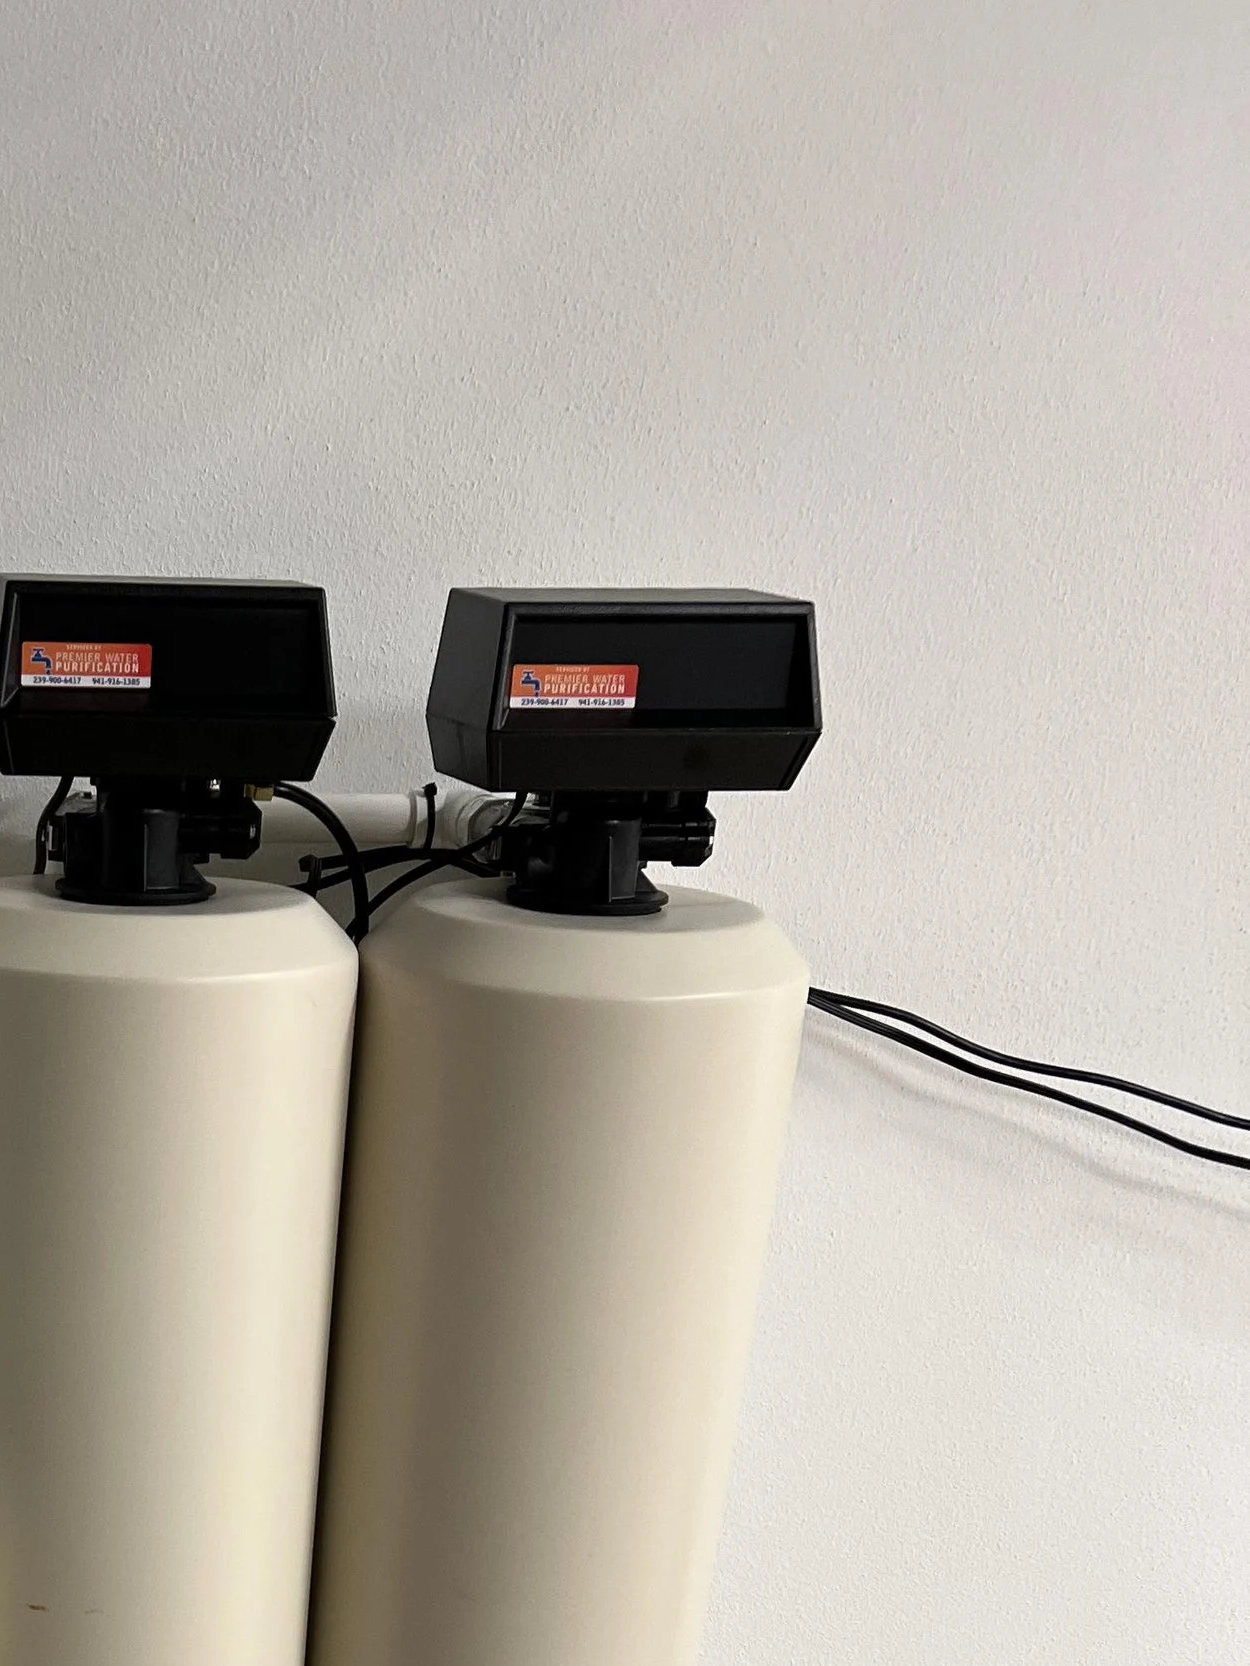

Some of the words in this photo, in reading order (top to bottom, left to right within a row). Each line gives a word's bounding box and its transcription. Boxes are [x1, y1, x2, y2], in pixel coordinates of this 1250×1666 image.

[55, 652, 101, 662] PREMIER
[105, 653, 139, 664] WATER
[55, 662, 140, 673] PURIFICATION
[544, 674, 589, 684] PREMIER
[592, 674, 626, 684] WATER
[543, 683, 625, 694] PURIFICATION
